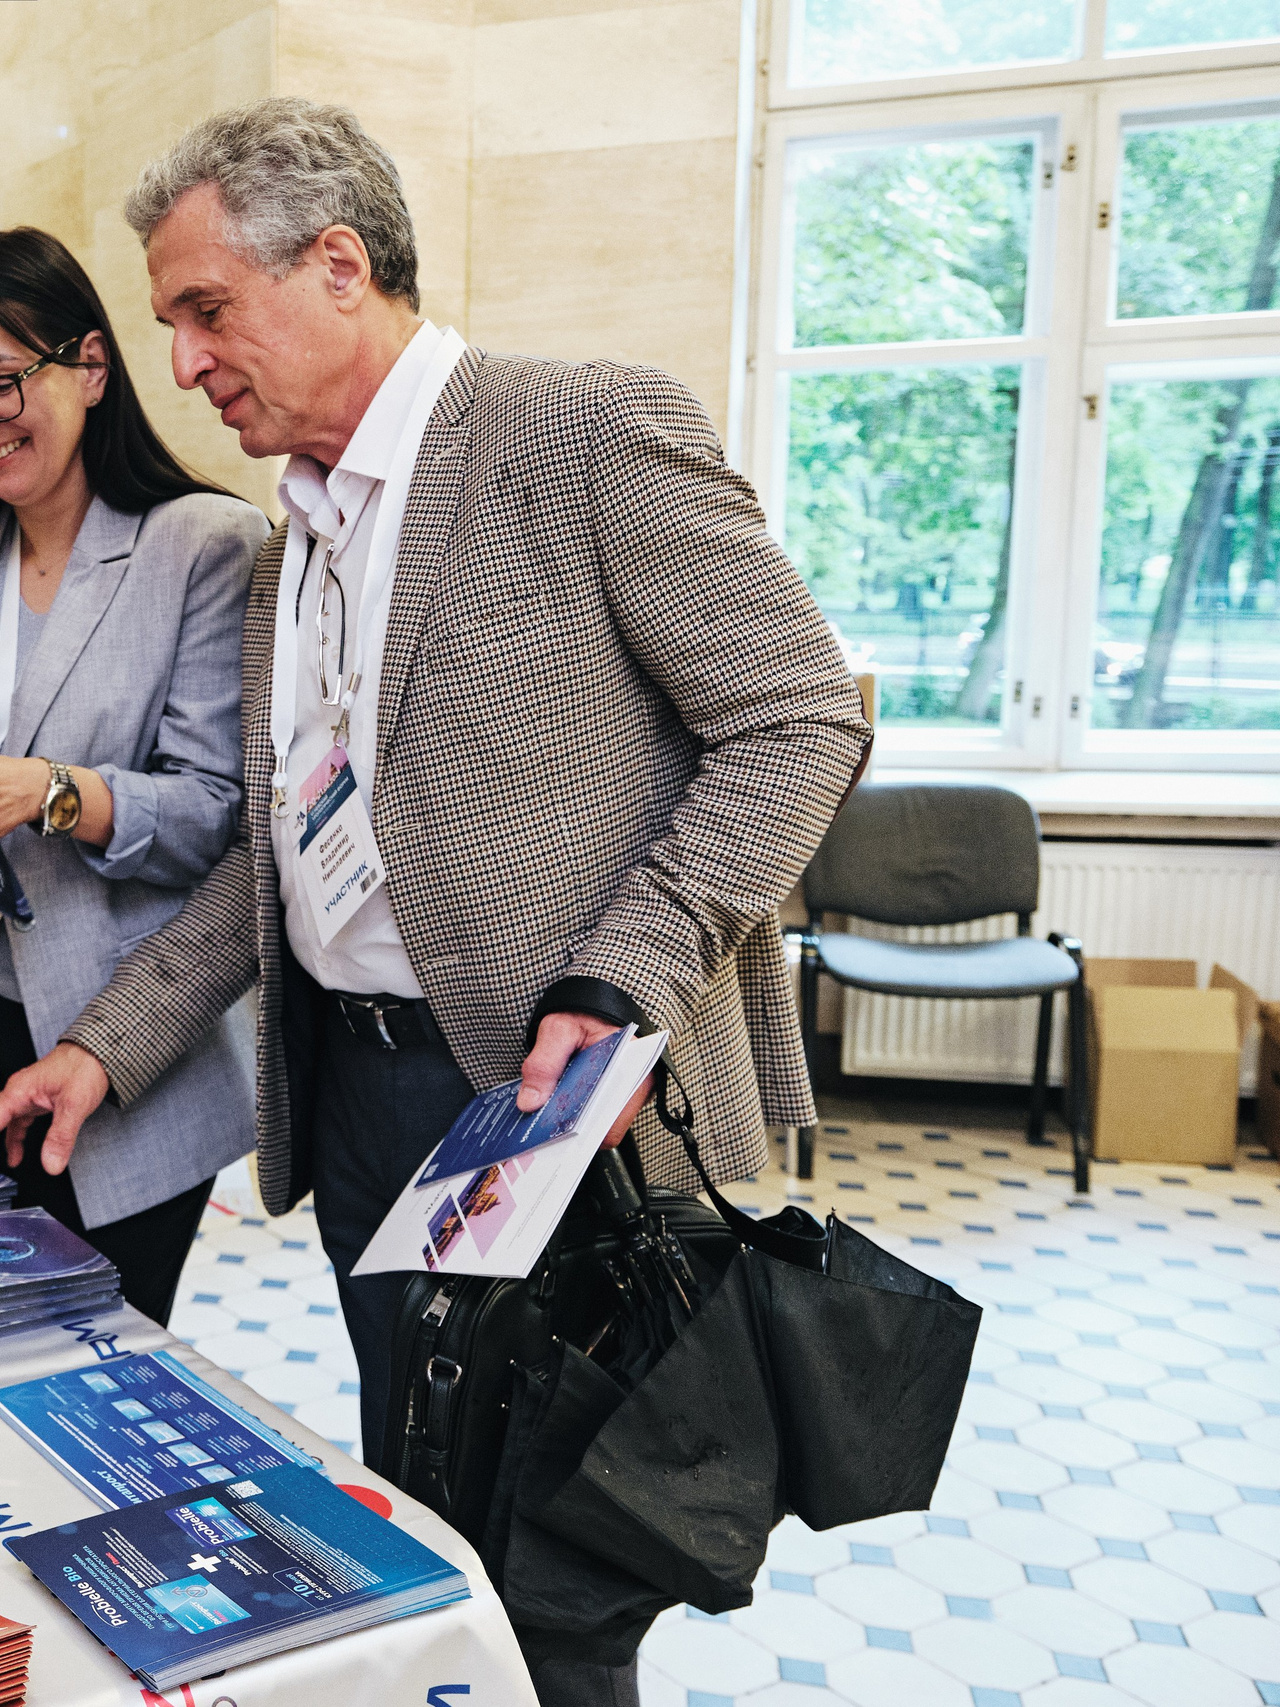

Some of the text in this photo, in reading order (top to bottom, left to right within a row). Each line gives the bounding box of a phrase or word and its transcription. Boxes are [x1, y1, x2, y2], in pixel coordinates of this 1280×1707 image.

[318, 824, 342, 853] Фесенко
[320, 833, 349, 869] Владимир
[321, 842, 355, 883] Николаевич
[324, 860, 368, 913] УЧАСТНИК
[97, 1470, 142, 1505] итапрост
[179, 1507, 227, 1544] Probielle
[82, 1544, 109, 1570] ПРОСТАТИТА
[84, 1557, 118, 1586] АНТИБИОТИКОВ
[62, 1565, 125, 1627] Probielle Bio
[95, 1577, 126, 1603] МИКРОФЛОРУ
[106, 1568, 145, 1602] БАКТЕРИАЛЬНОГО
[115, 1586, 135, 1603] ПРИЕМА
[292, 1583, 315, 1597] 10
[294, 1570, 332, 1598] КУРС ПРИЕМА
[122, 1602, 154, 1629] ПОДДЕРЖИТЕ
[131, 1601, 149, 1615] ВРЕМЯ
[161, 1618, 174, 1628] ПРИ
